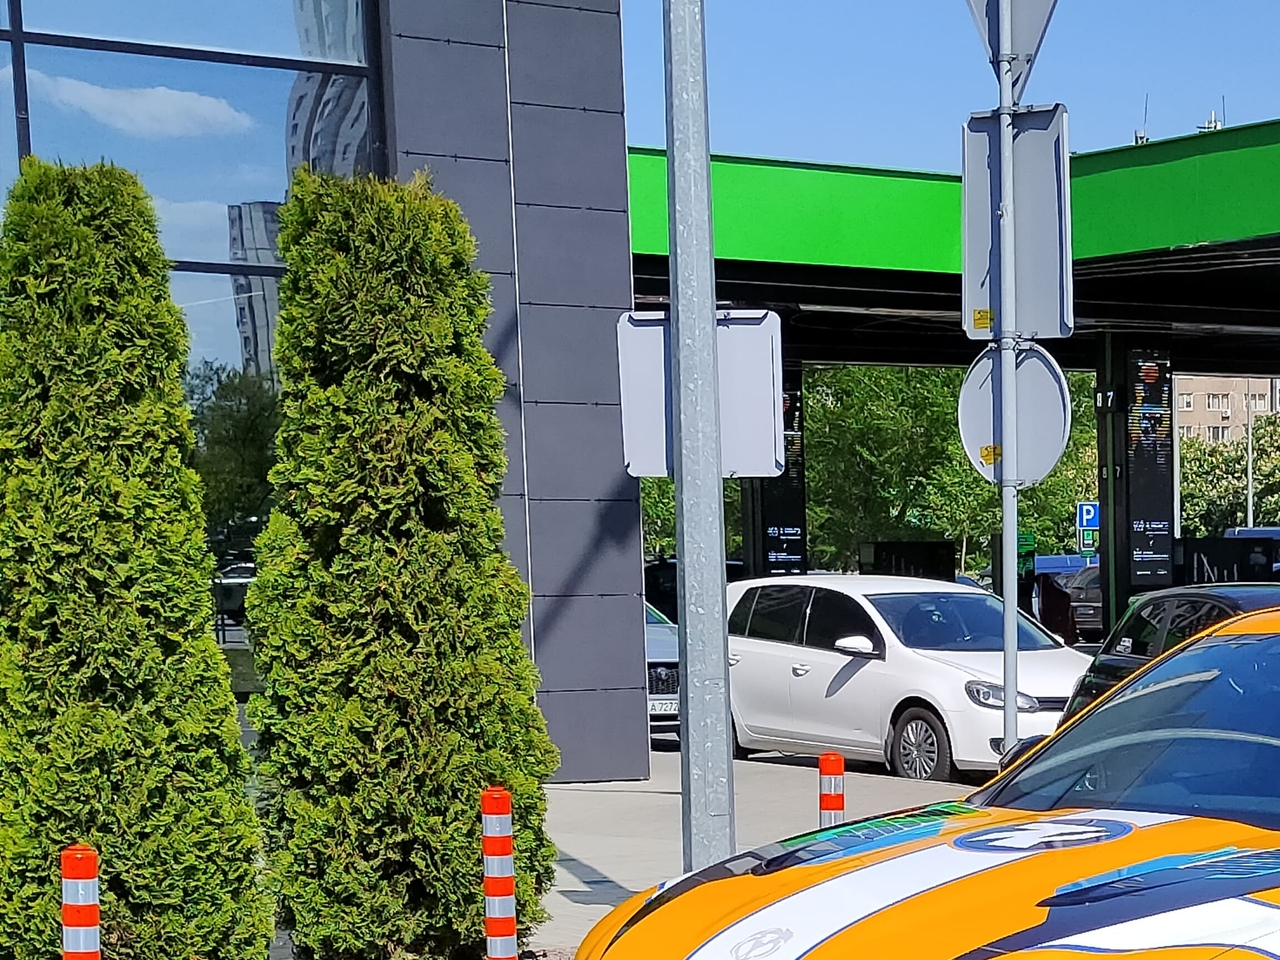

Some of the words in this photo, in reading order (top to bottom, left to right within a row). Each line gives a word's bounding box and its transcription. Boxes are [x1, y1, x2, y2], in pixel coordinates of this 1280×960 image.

[1106, 391, 1114, 408] 7
[1115, 465, 1121, 478] 7
[1082, 505, 1095, 527] P
